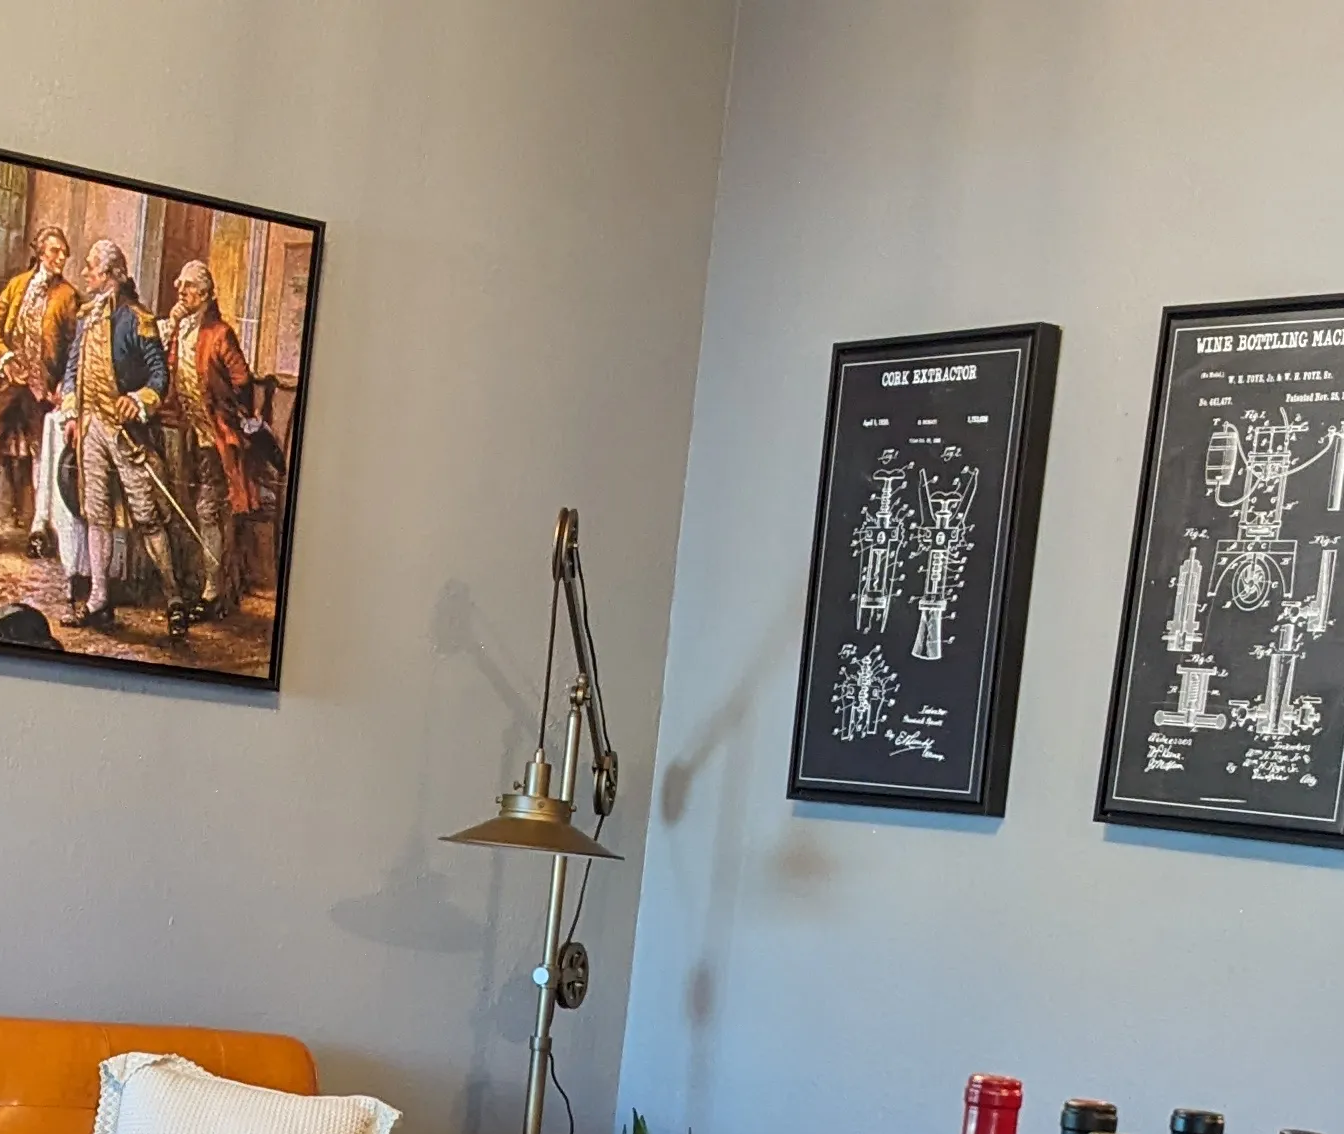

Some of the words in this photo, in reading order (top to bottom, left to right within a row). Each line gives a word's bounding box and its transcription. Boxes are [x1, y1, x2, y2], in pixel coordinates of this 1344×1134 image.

[1196, 335, 1233, 354] WINE
[1237, 331, 1308, 352] BOTTLING
[881, 370, 910, 387] CORK
[912, 365, 977, 384] EXTRACTOR
[1286, 392, 1314, 402] Patented
